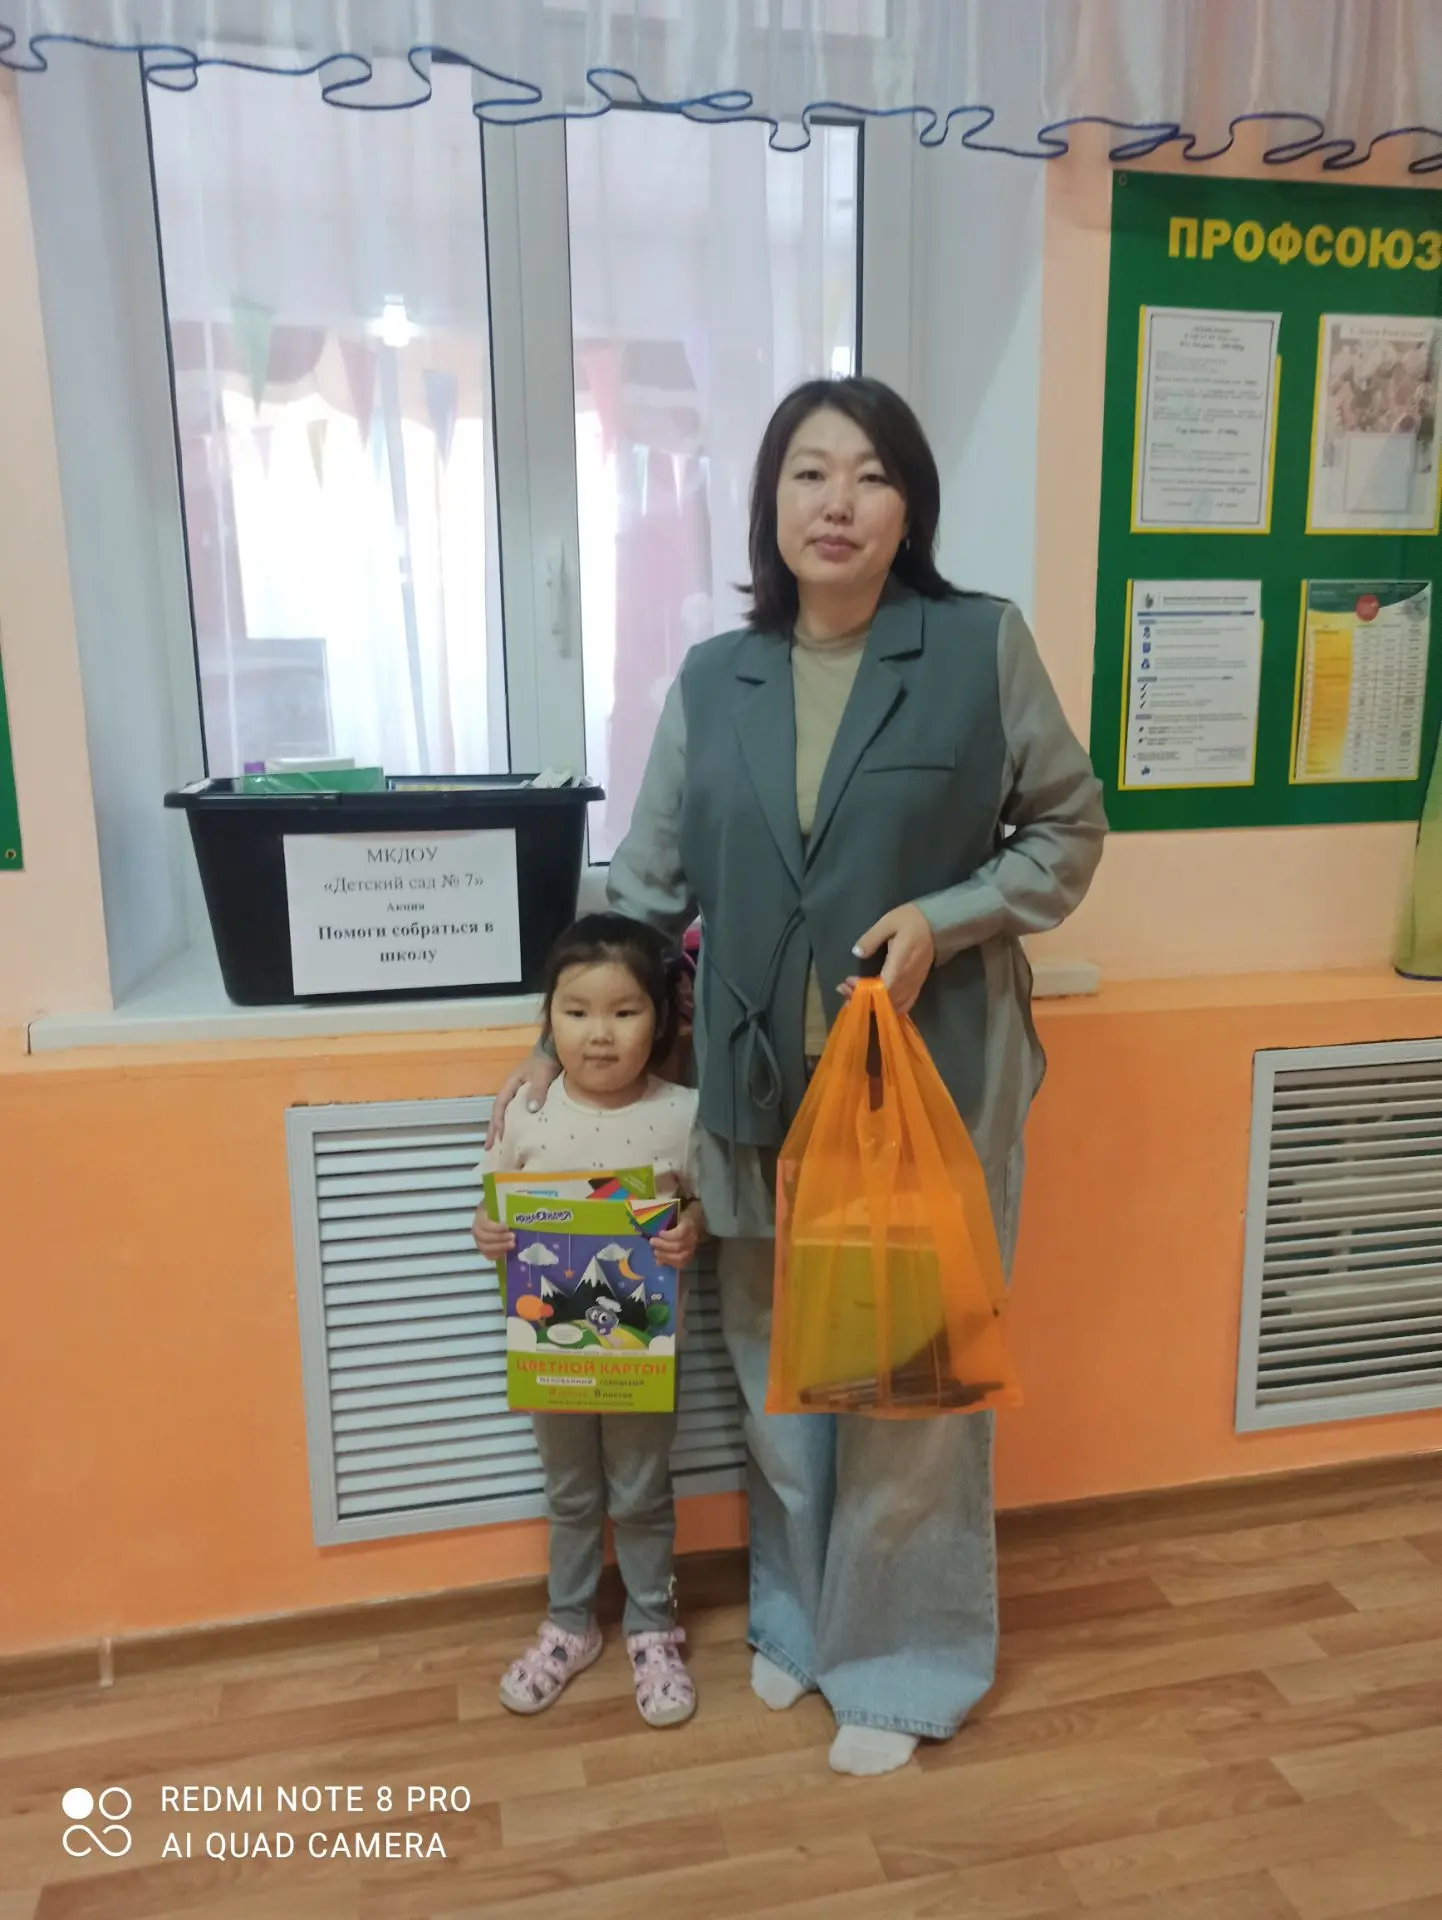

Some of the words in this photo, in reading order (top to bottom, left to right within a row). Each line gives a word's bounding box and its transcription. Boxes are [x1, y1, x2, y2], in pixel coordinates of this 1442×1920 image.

[1168, 216, 1442, 270] ПРОФСОЮЗ
[367, 846, 438, 864] МКДОУ
[323, 875, 404, 895] «Детский
[409, 877, 436, 891] сад
[441, 873, 460, 889] №
[464, 872, 484, 887] 7»
[386, 901, 425, 912] Акция
[318, 924, 387, 941] Помоги
[392, 921, 478, 939] собраться
[484, 922, 495, 933] в
[380, 948, 438, 964] школу
[516, 1356, 596, 1375] ЦВЕТНОЙ
[600, 1362, 668, 1376] КАРТОН
